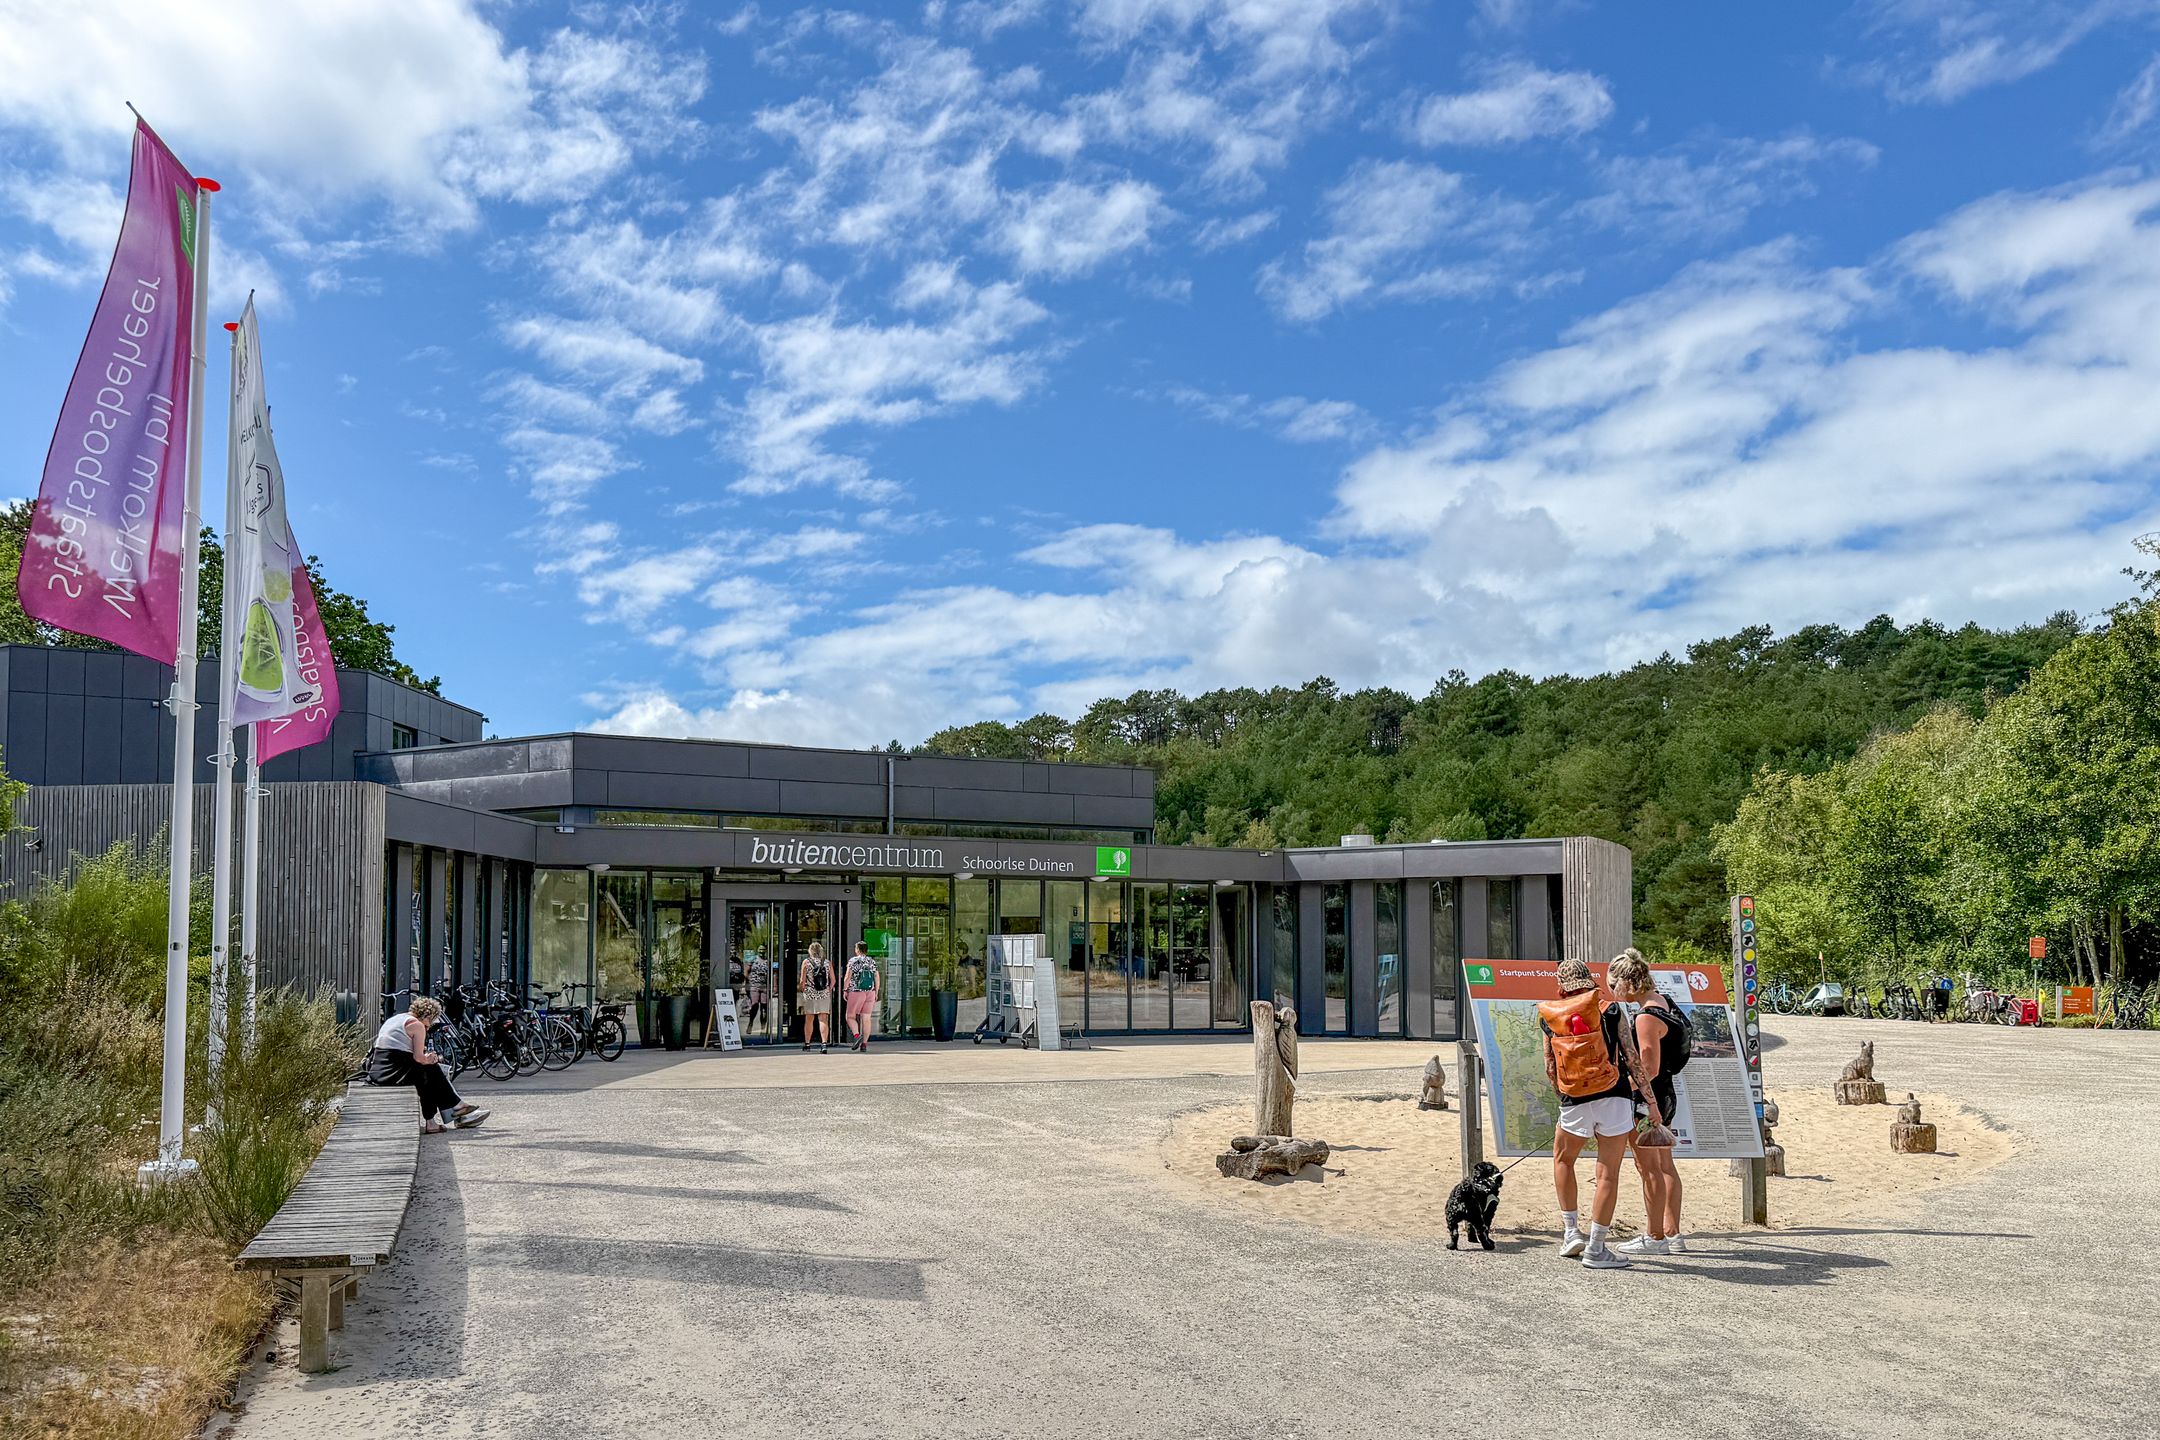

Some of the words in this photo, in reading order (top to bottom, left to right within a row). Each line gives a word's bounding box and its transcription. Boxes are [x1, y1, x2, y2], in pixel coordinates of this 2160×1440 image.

[751, 837, 945, 868] buitencentrum
[962, 855, 1025, 871] Schoorlse
[1029, 857, 1074, 872] Duinen
[1499, 968, 1535, 978] Startpunt
